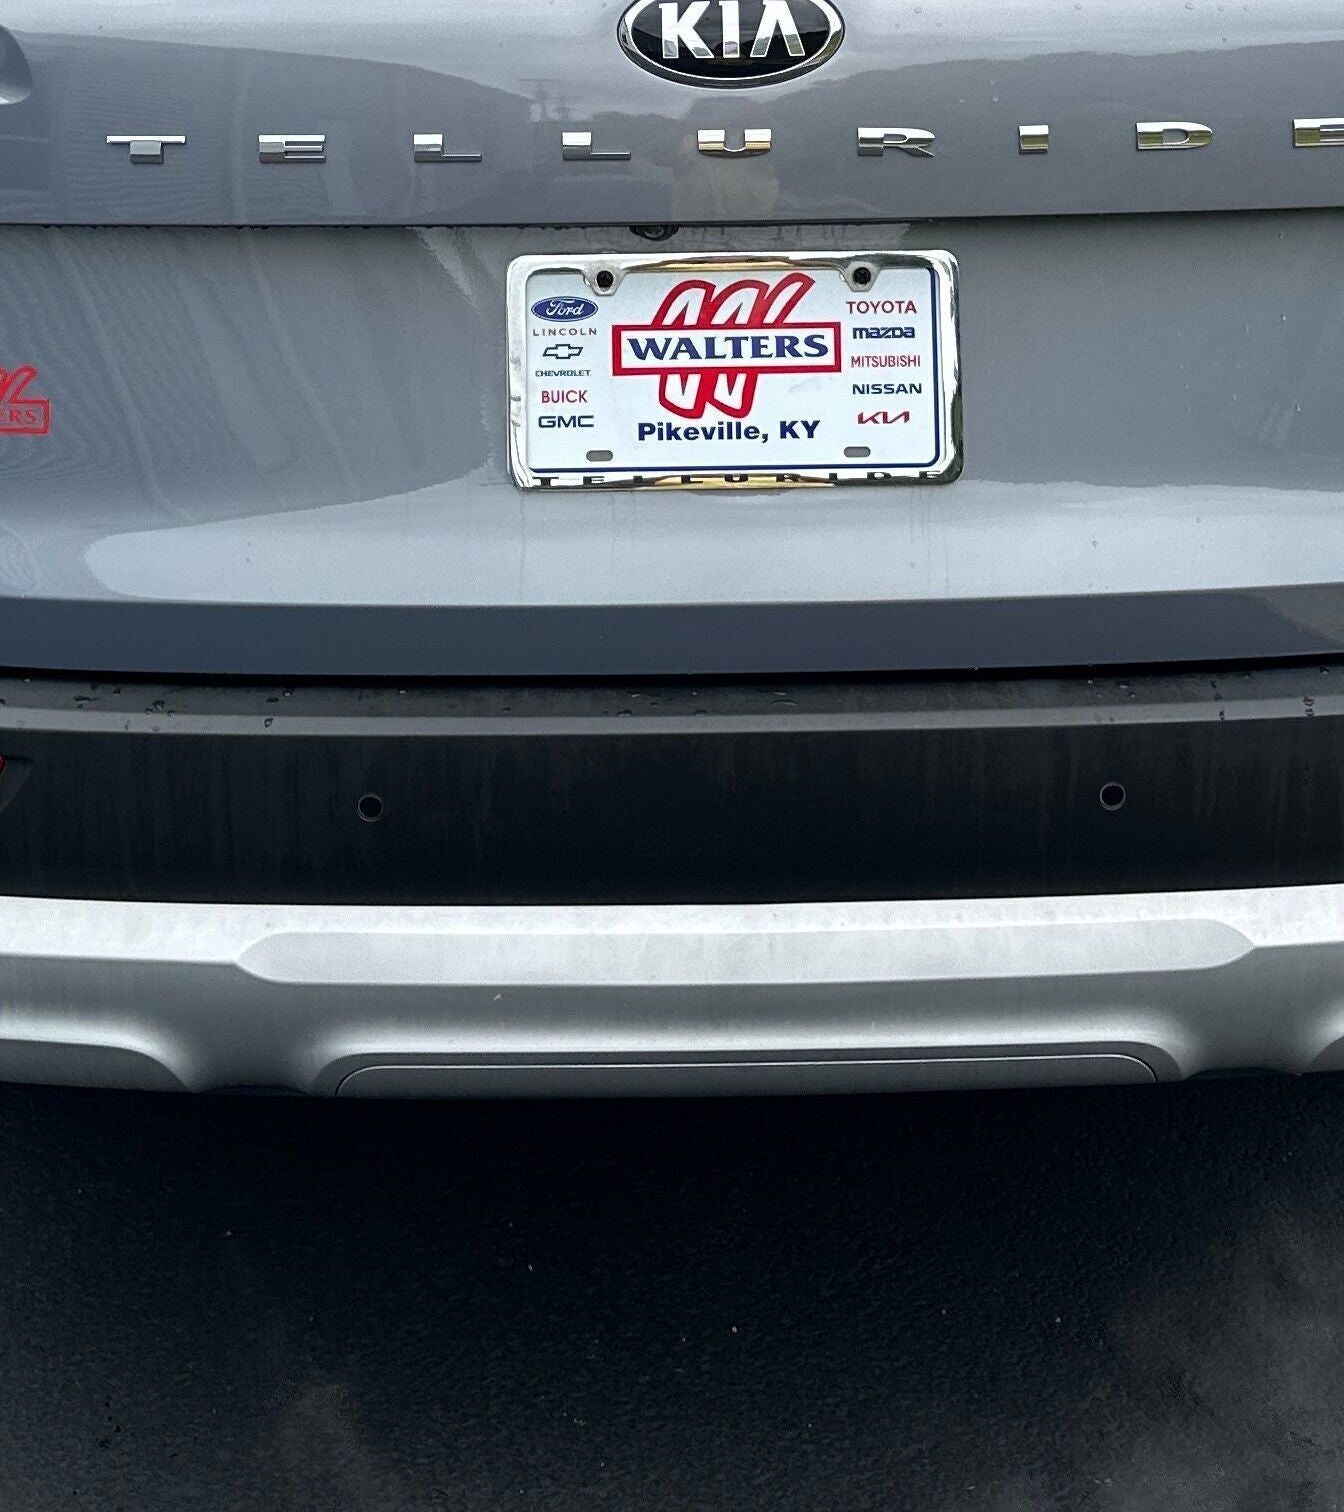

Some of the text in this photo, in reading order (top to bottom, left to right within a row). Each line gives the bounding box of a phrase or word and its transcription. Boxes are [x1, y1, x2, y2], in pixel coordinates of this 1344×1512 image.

[658, 0, 806, 59] KIA
[545, 298, 585, 317] Ford
[845, 299, 918, 315] TOYOTA
[532, 327, 597, 337] LINCOLN
[627, 334, 829, 361] WALTERS
[850, 354, 922, 368] MITSUBISHI
[535, 369, 592, 377] CHEVROLET
[852, 382, 923, 395] NISSAN
[541, 389, 588, 404] BUICK
[538, 414, 595, 428] GMC
[638, 419, 821, 442] Pikeville, KY
